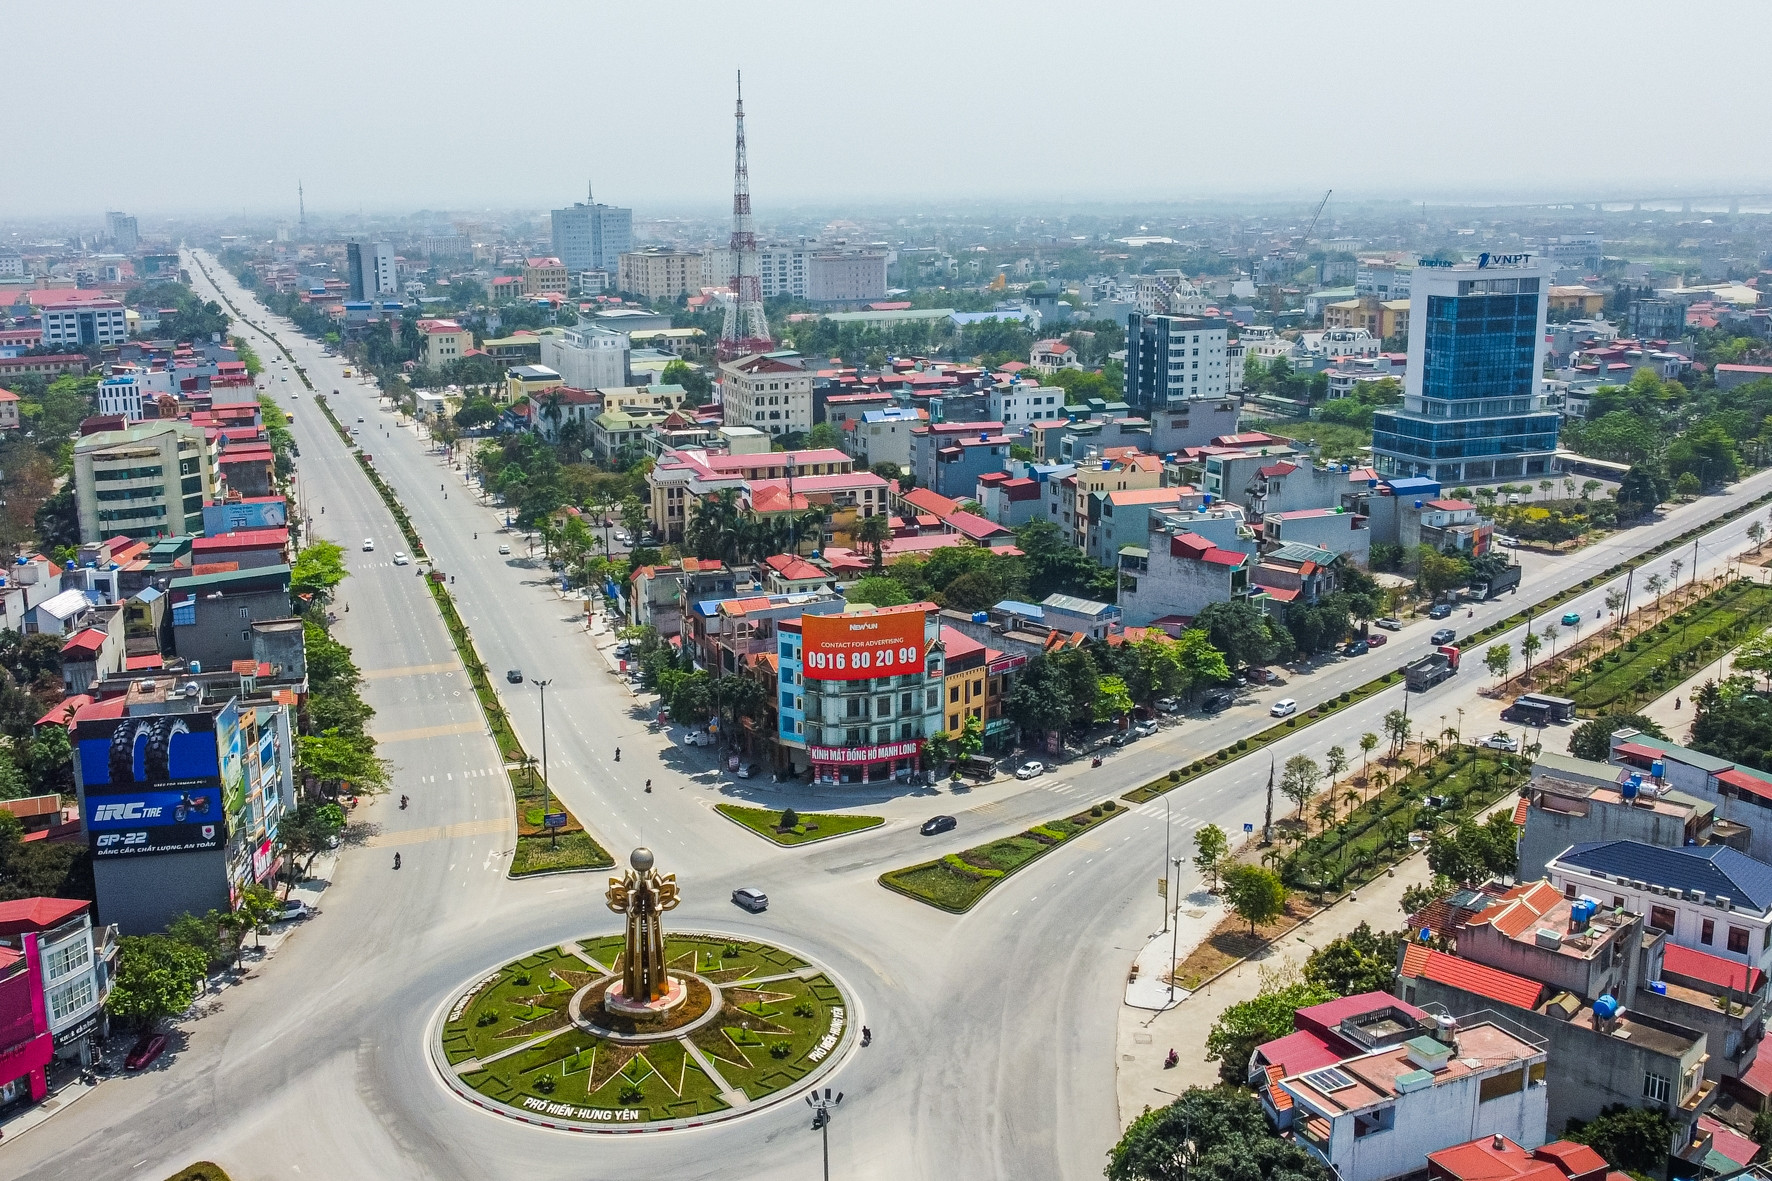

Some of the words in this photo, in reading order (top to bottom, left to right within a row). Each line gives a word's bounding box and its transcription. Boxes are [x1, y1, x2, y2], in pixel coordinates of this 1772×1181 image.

[1492, 254, 1532, 265] VNPT
[821, 641, 851, 649] CONTACT
[865, 637, 904, 647] ADVERTISING
[808, 651, 846, 669] 0916
[851, 651, 871, 669] 80
[875, 649, 894, 667] 20
[899, 646, 917, 664] 99
[811, 747, 829, 760] KÍNH
[878, 745, 898, 760] MẠNH
[899, 742, 917, 755] LONG
[142, 806, 162, 818] TIRE
[96, 831, 148, 847] GP-22
[523, 1097, 551, 1111] PHỐ
[614, 1108, 639, 1120] YÊN
